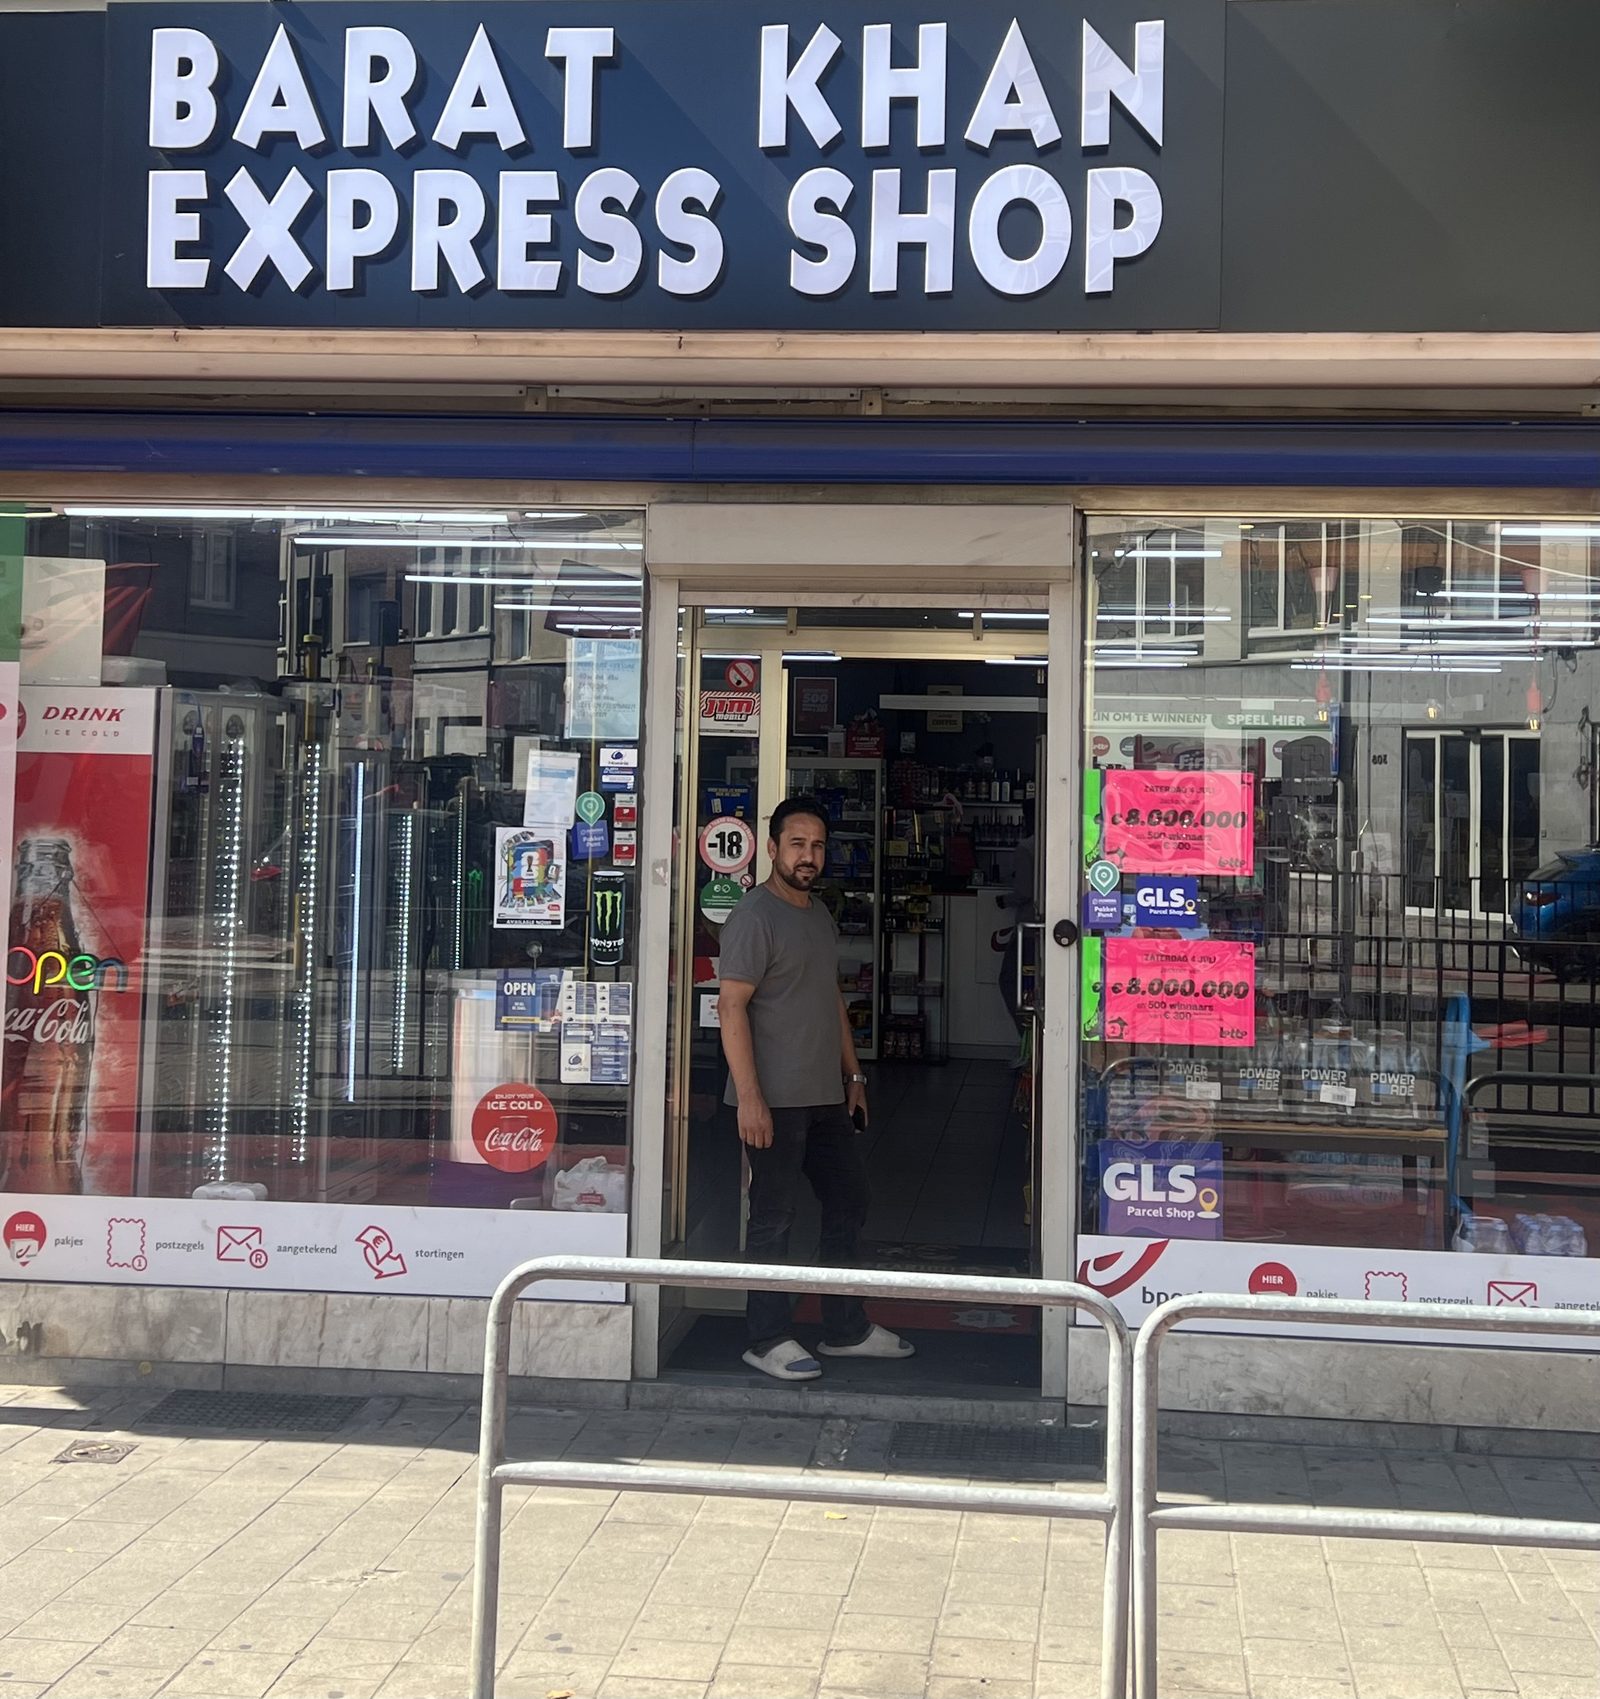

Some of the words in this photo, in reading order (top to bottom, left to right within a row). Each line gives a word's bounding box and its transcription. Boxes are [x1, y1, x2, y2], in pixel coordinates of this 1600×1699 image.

[148, 22, 615, 150] BARAT
[758, 17, 1165, 149] KHAN
[146, 165, 724, 294] EXPRESS
[788, 163, 1163, 295] SHOP
[42, 706, 125, 722] DRINK
[1112, 712, 1132, 721] OM
[1135, 712, 1149, 722] TE
[1152, 712, 1208, 723] WINNEN?
[1227, 714, 1269, 725] SPEEL
[1272, 714, 1306, 726] HIER
[45, 729, 71, 737] ICE
[81, 729, 120, 738] COLD
[1125, 808, 1246, 828] 8.000.000
[708, 831, 742, 859] -18
[1137, 887, 1185, 908] GLS
[1144, 953, 1188, 963] ZATERDAG
[503, 982, 536, 996] OPEN
[1111, 982, 1123, 994] €
[1126, 977, 1249, 999] 8.000.000
[1148, 1001, 1167, 1009] 500
[1169, 1001, 1214, 1011] winnaars
[4, 998, 90, 1044] ca-Cola
[1220, 1027, 1247, 1039] lotto
[1240, 1067, 1280, 1079] POWER
[1301, 1069, 1346, 1081] POWER
[1370, 1073, 1415, 1085] POWER
[1257, 1079, 1280, 1090] ADE
[1390, 1084, 1415, 1096] ADE
[487, 1101, 507, 1110] ICE
[509, 1101, 543, 1110] COLD
[485, 1127, 545, 1152] Coca-Cola
[1103, 1162, 1197, 1203] GLS
[1127, 1206, 1163, 1217] Parcel
[1166, 1207, 1195, 1221] Shop
[15, 1223, 35, 1232] HIER
[54, 1235, 84, 1248] pakjes
[155, 1239, 205, 1252] postzegels
[276, 1243, 337, 1255] aangetekend
[415, 1248, 465, 1261] stortingen
[1262, 1275, 1284, 1285] HIER
[1142, 1286, 1203, 1308] bpo
